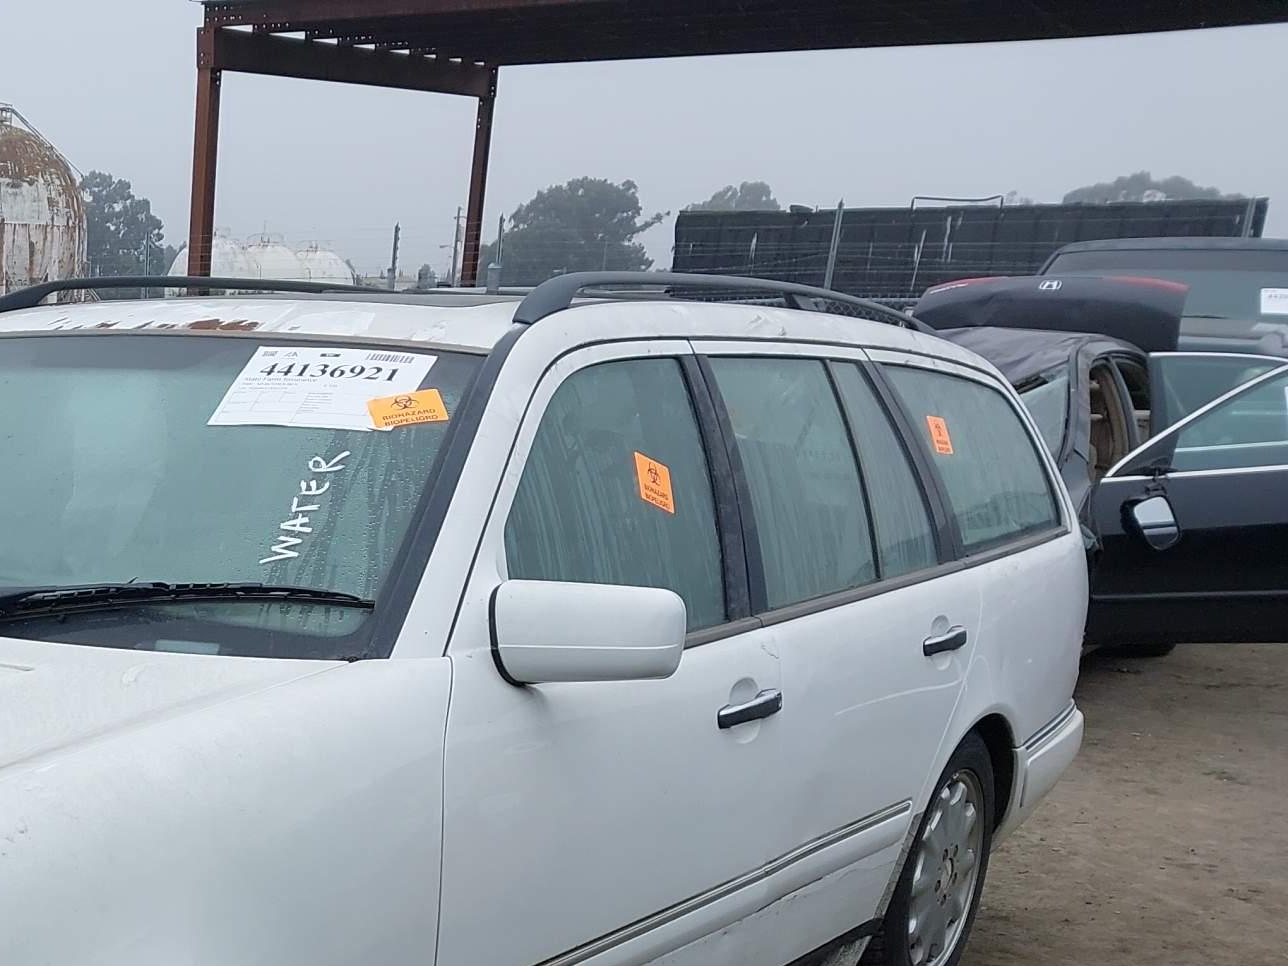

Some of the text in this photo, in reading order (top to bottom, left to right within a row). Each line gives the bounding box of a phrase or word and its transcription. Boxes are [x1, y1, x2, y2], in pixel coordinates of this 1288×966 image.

[259, 362, 400, 382] 44136921
[382, 408, 436, 421] BIOHAZARD
[384, 415, 439, 427] BIOPELIGRO
[258, 450, 352, 564] WATER
